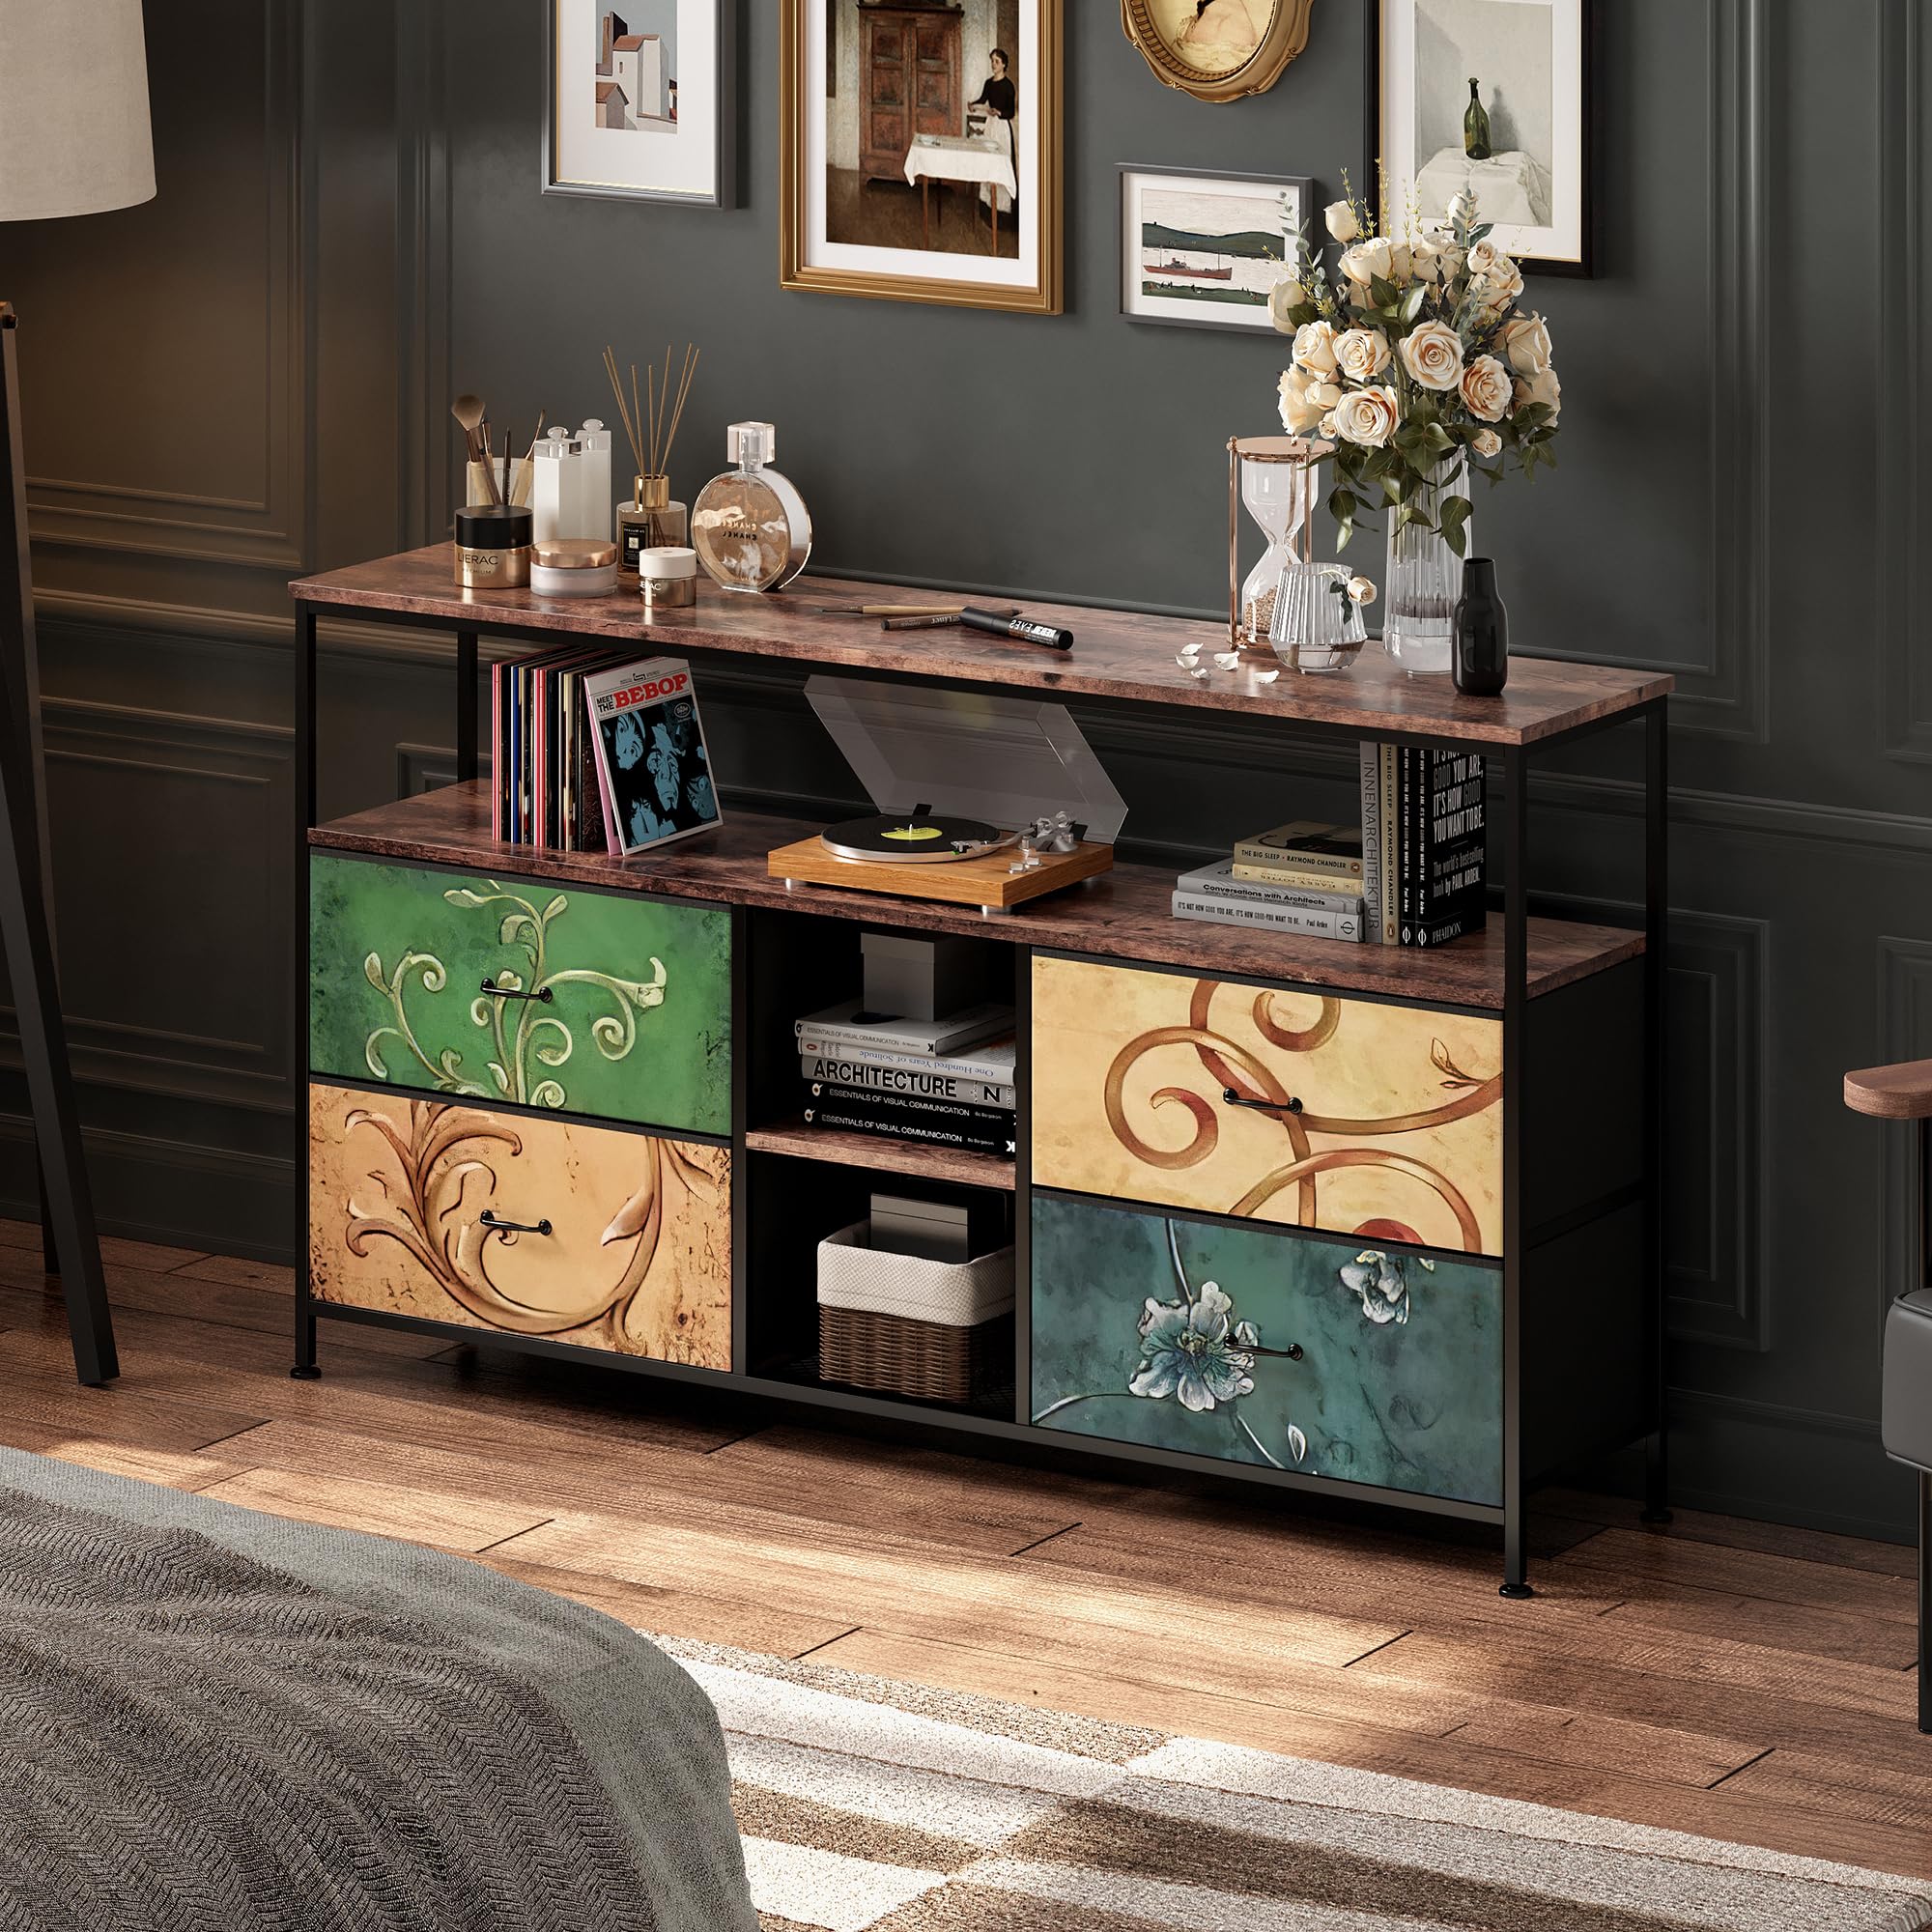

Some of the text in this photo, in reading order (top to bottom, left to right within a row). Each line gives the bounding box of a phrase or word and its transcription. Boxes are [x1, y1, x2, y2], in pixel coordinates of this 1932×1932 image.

[458, 553, 497, 564] LIERAC
[597, 695, 612, 704] MEET
[612, 673, 688, 708] BEBOP
[598, 702, 614, 712] THE
[1434, 764, 1450, 791] GOOD
[1454, 757, 1465, 783] YOU
[1434, 780, 1480, 817] IT'S HOW GOOD
[1434, 817, 1446, 843] YOU
[1447, 811, 1464, 838] WANT
[1364, 762, 1379, 929] INNENARCHITEKTUR
[1287, 856, 1315, 865] RAYMOND
[1317, 860, 1347, 868] CHANDLER
[1204, 885, 1262, 896] Conversations
[1284, 895, 1324, 905] Architects
[1445, 878, 1451, 895] by
[1433, 922, 1461, 943] PHAIDON
[808, 1028, 834, 1037] ESSENTIALS
[860, 1036, 899, 1046] COMMUNICATION
[860, 1050, 894, 1062] Solitude
[908, 1059, 931, 1067] Years
[935, 1062, 972, 1073] Hundred
[975, 1068, 994, 1077] One
[813, 1060, 956, 1097] ARCHITECTURE
[830, 1089, 871, 1102] ESSENTIALS
[883, 1097, 908, 1107] VISUAL
[909, 1101, 970, 1117] COMMUNICATION
[822, 1115, 864, 1127] ESSENTIALS
[875, 1123, 900, 1133] VISUAL
[901, 1126, 962, 1143] COMMUNICATION
